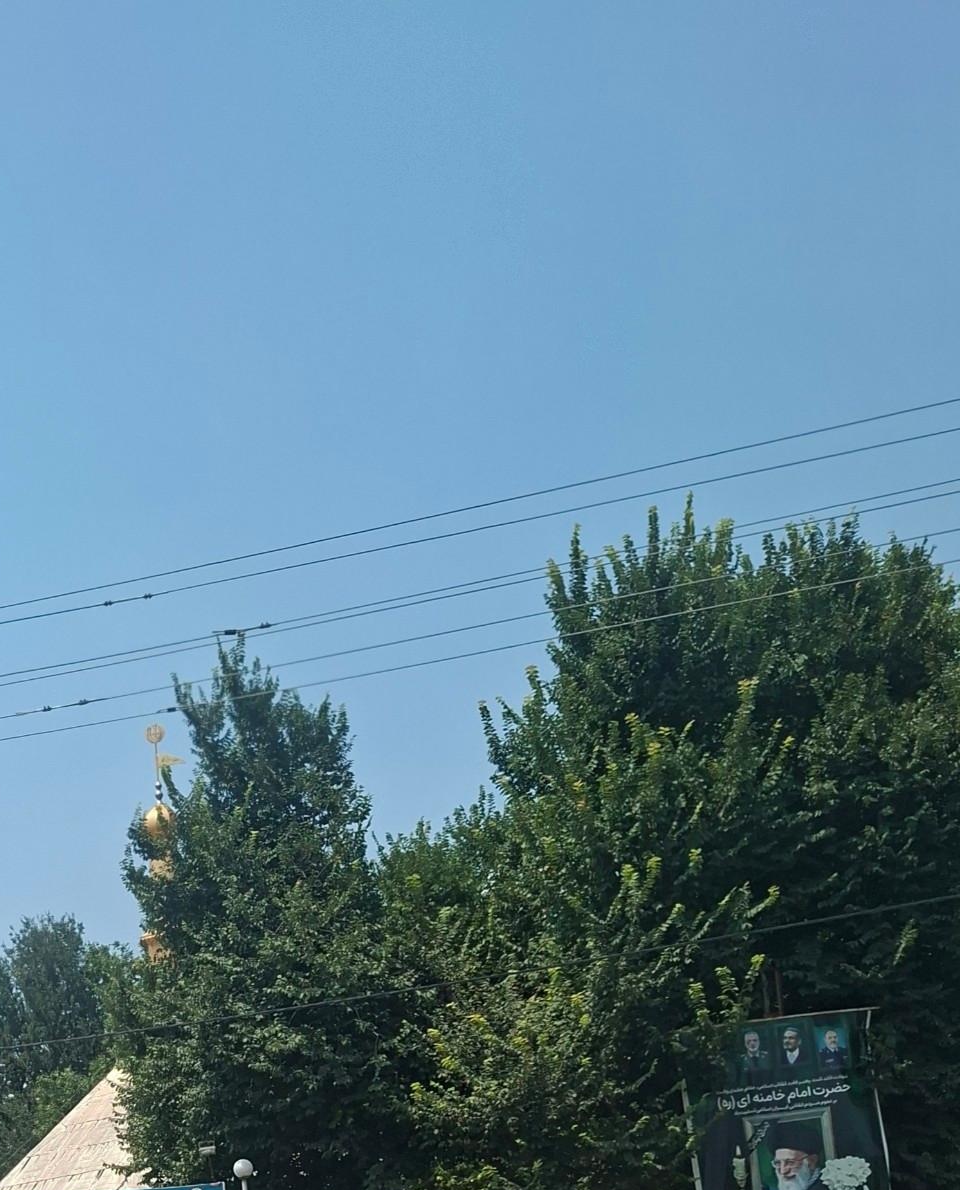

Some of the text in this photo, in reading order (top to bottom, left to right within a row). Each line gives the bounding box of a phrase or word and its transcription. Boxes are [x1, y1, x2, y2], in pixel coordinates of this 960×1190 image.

[753, 1089, 785, 1103] خامنه
[787, 1086, 812, 1103] امام
[813, 1082, 851, 1097] حضرت
[737, 1094, 750, 1108] ای
